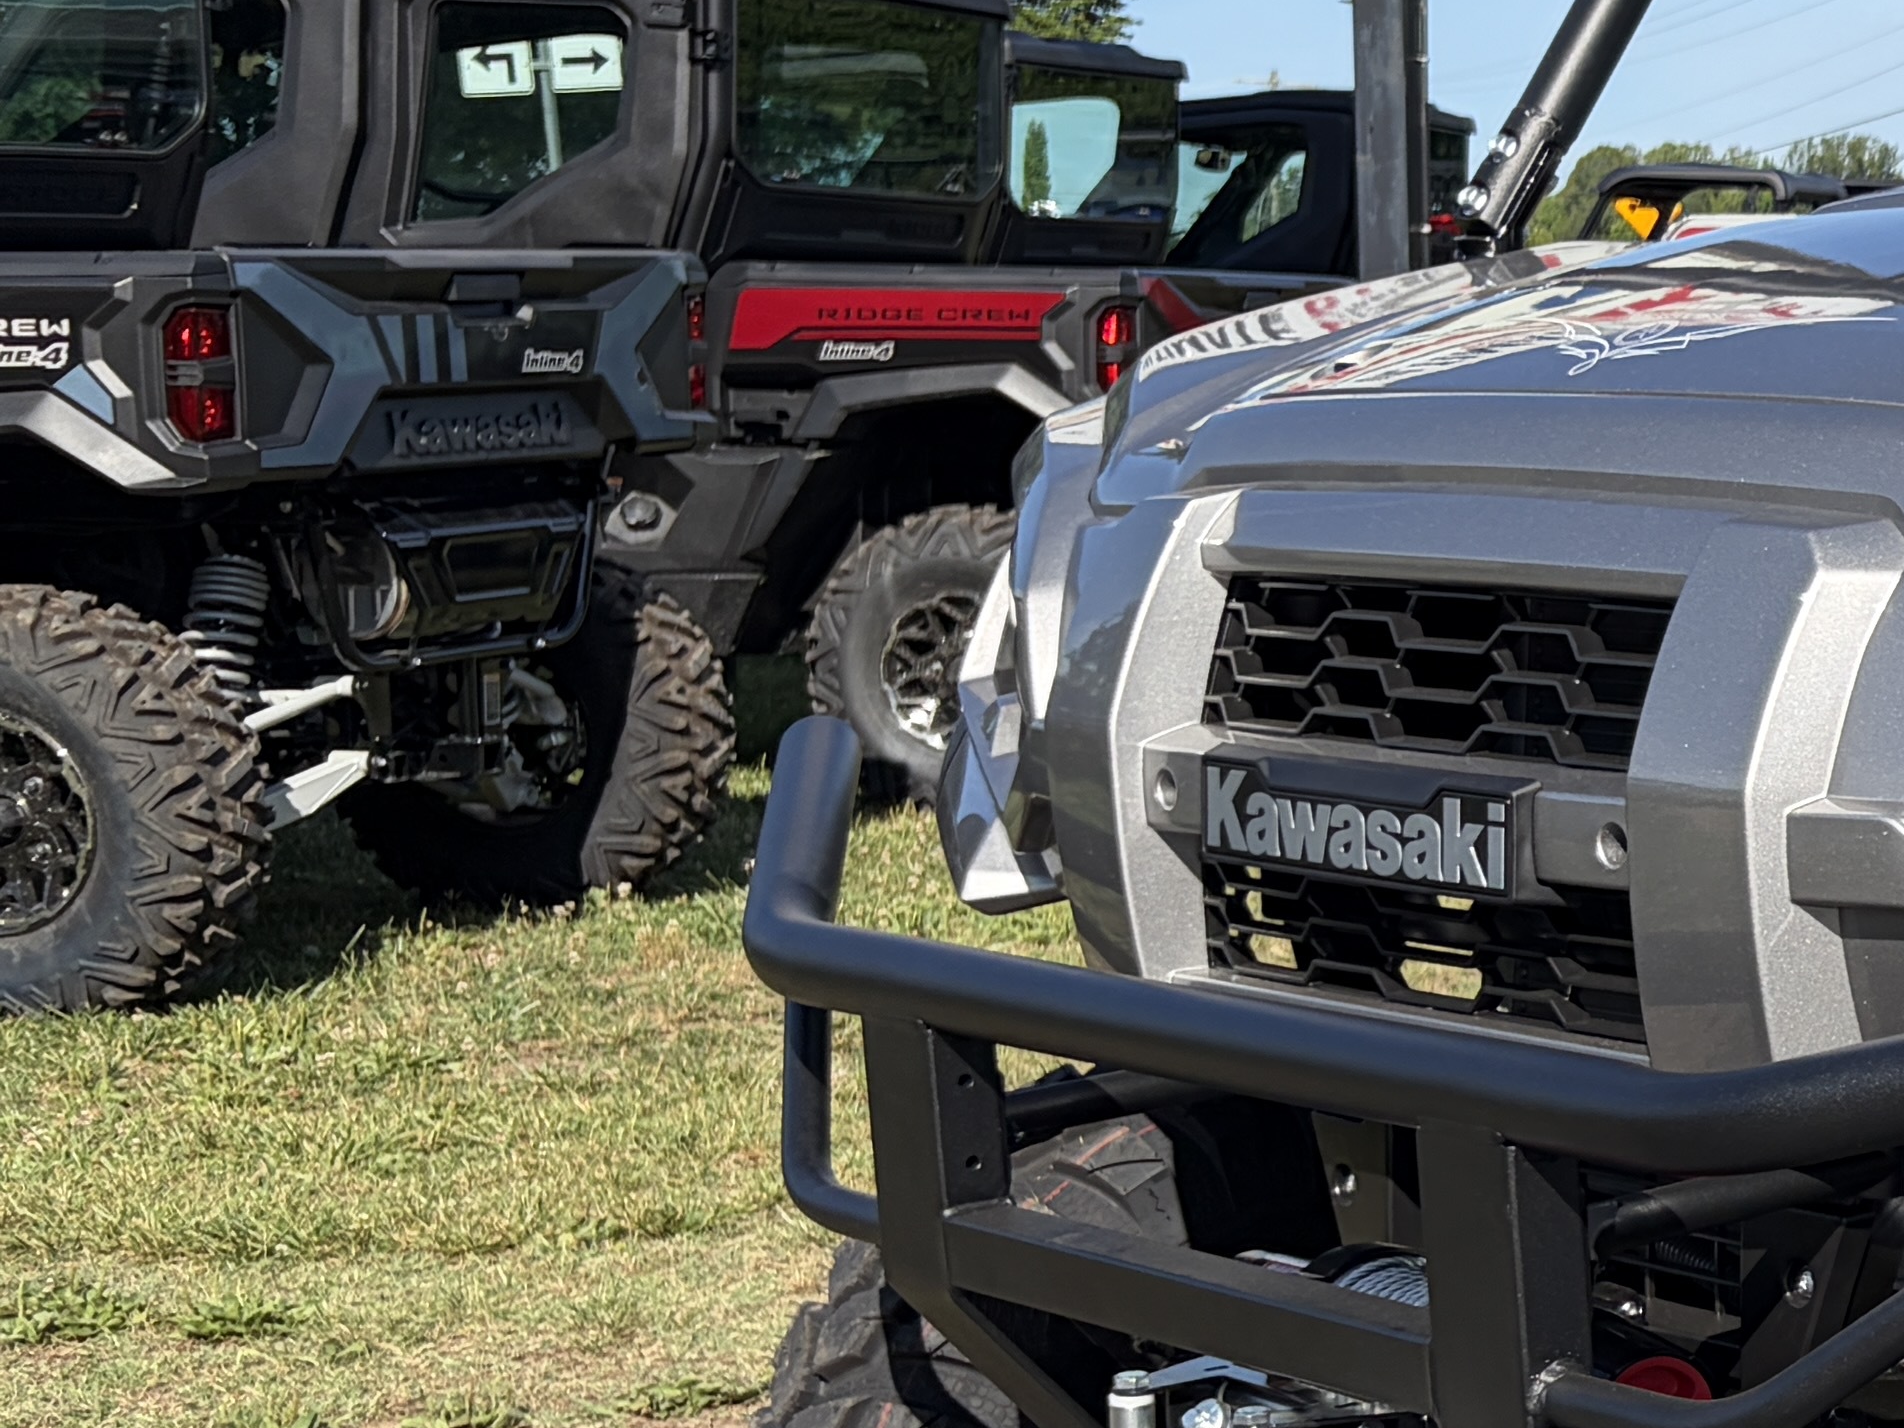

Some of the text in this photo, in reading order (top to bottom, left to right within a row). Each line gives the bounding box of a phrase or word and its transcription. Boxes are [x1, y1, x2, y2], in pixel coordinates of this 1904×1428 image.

[817, 307, 1031, 321] RIDGE CREW
[1206, 765, 1505, 890] Kawasaki
